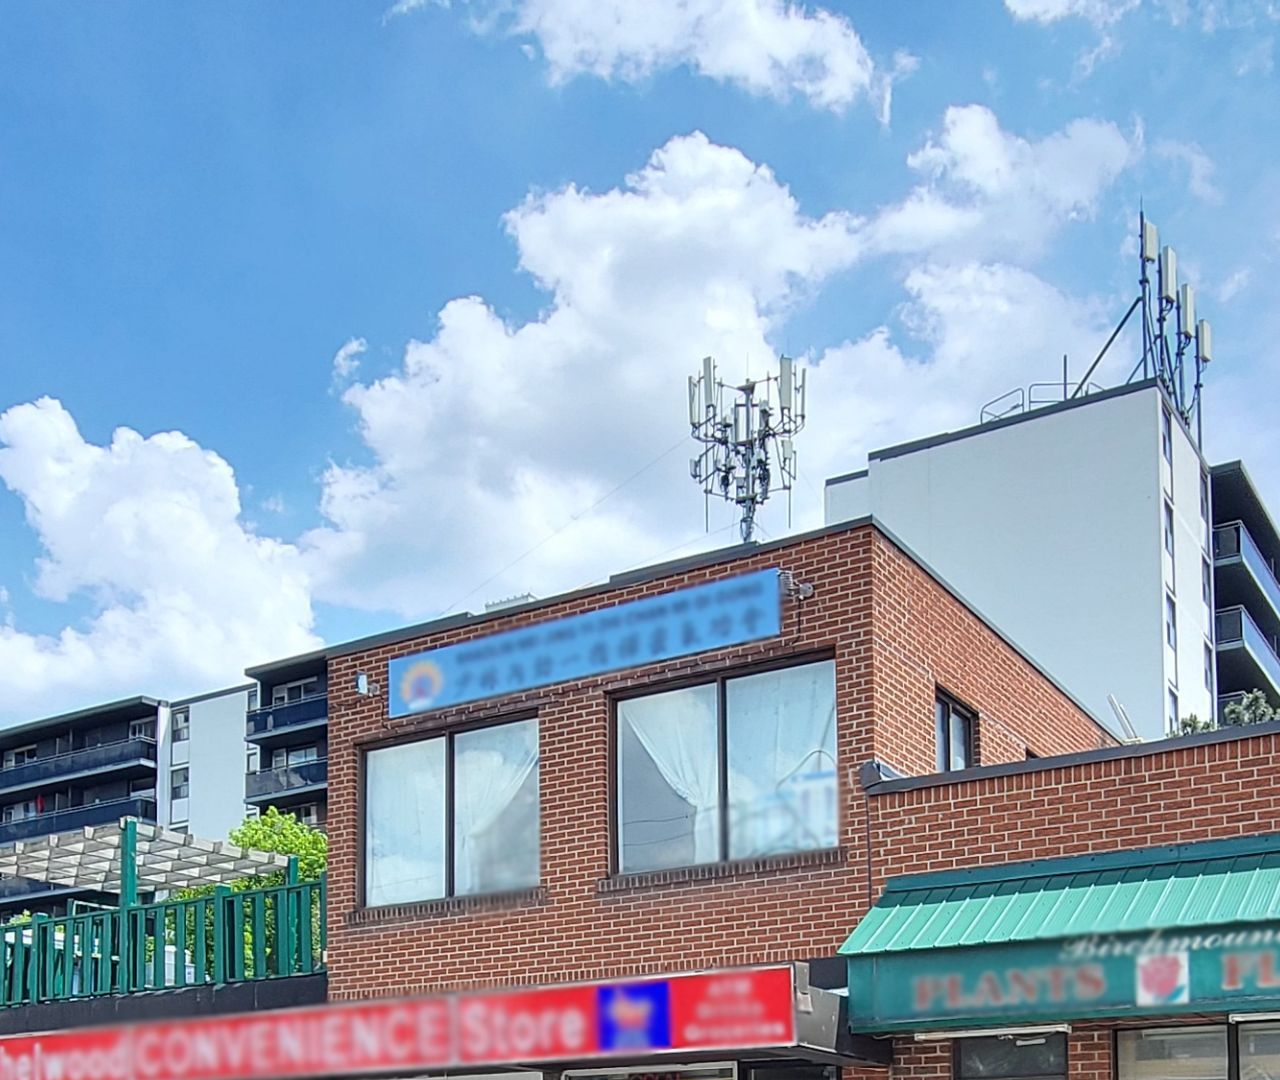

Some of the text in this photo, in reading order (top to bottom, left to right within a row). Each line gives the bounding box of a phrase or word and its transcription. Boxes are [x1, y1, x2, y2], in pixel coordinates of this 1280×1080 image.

[913, 963, 1106, 1010] PLANTS
[137, 1007, 447, 1080] CONVENIENCE
[462, 1002, 586, 1051] Store
